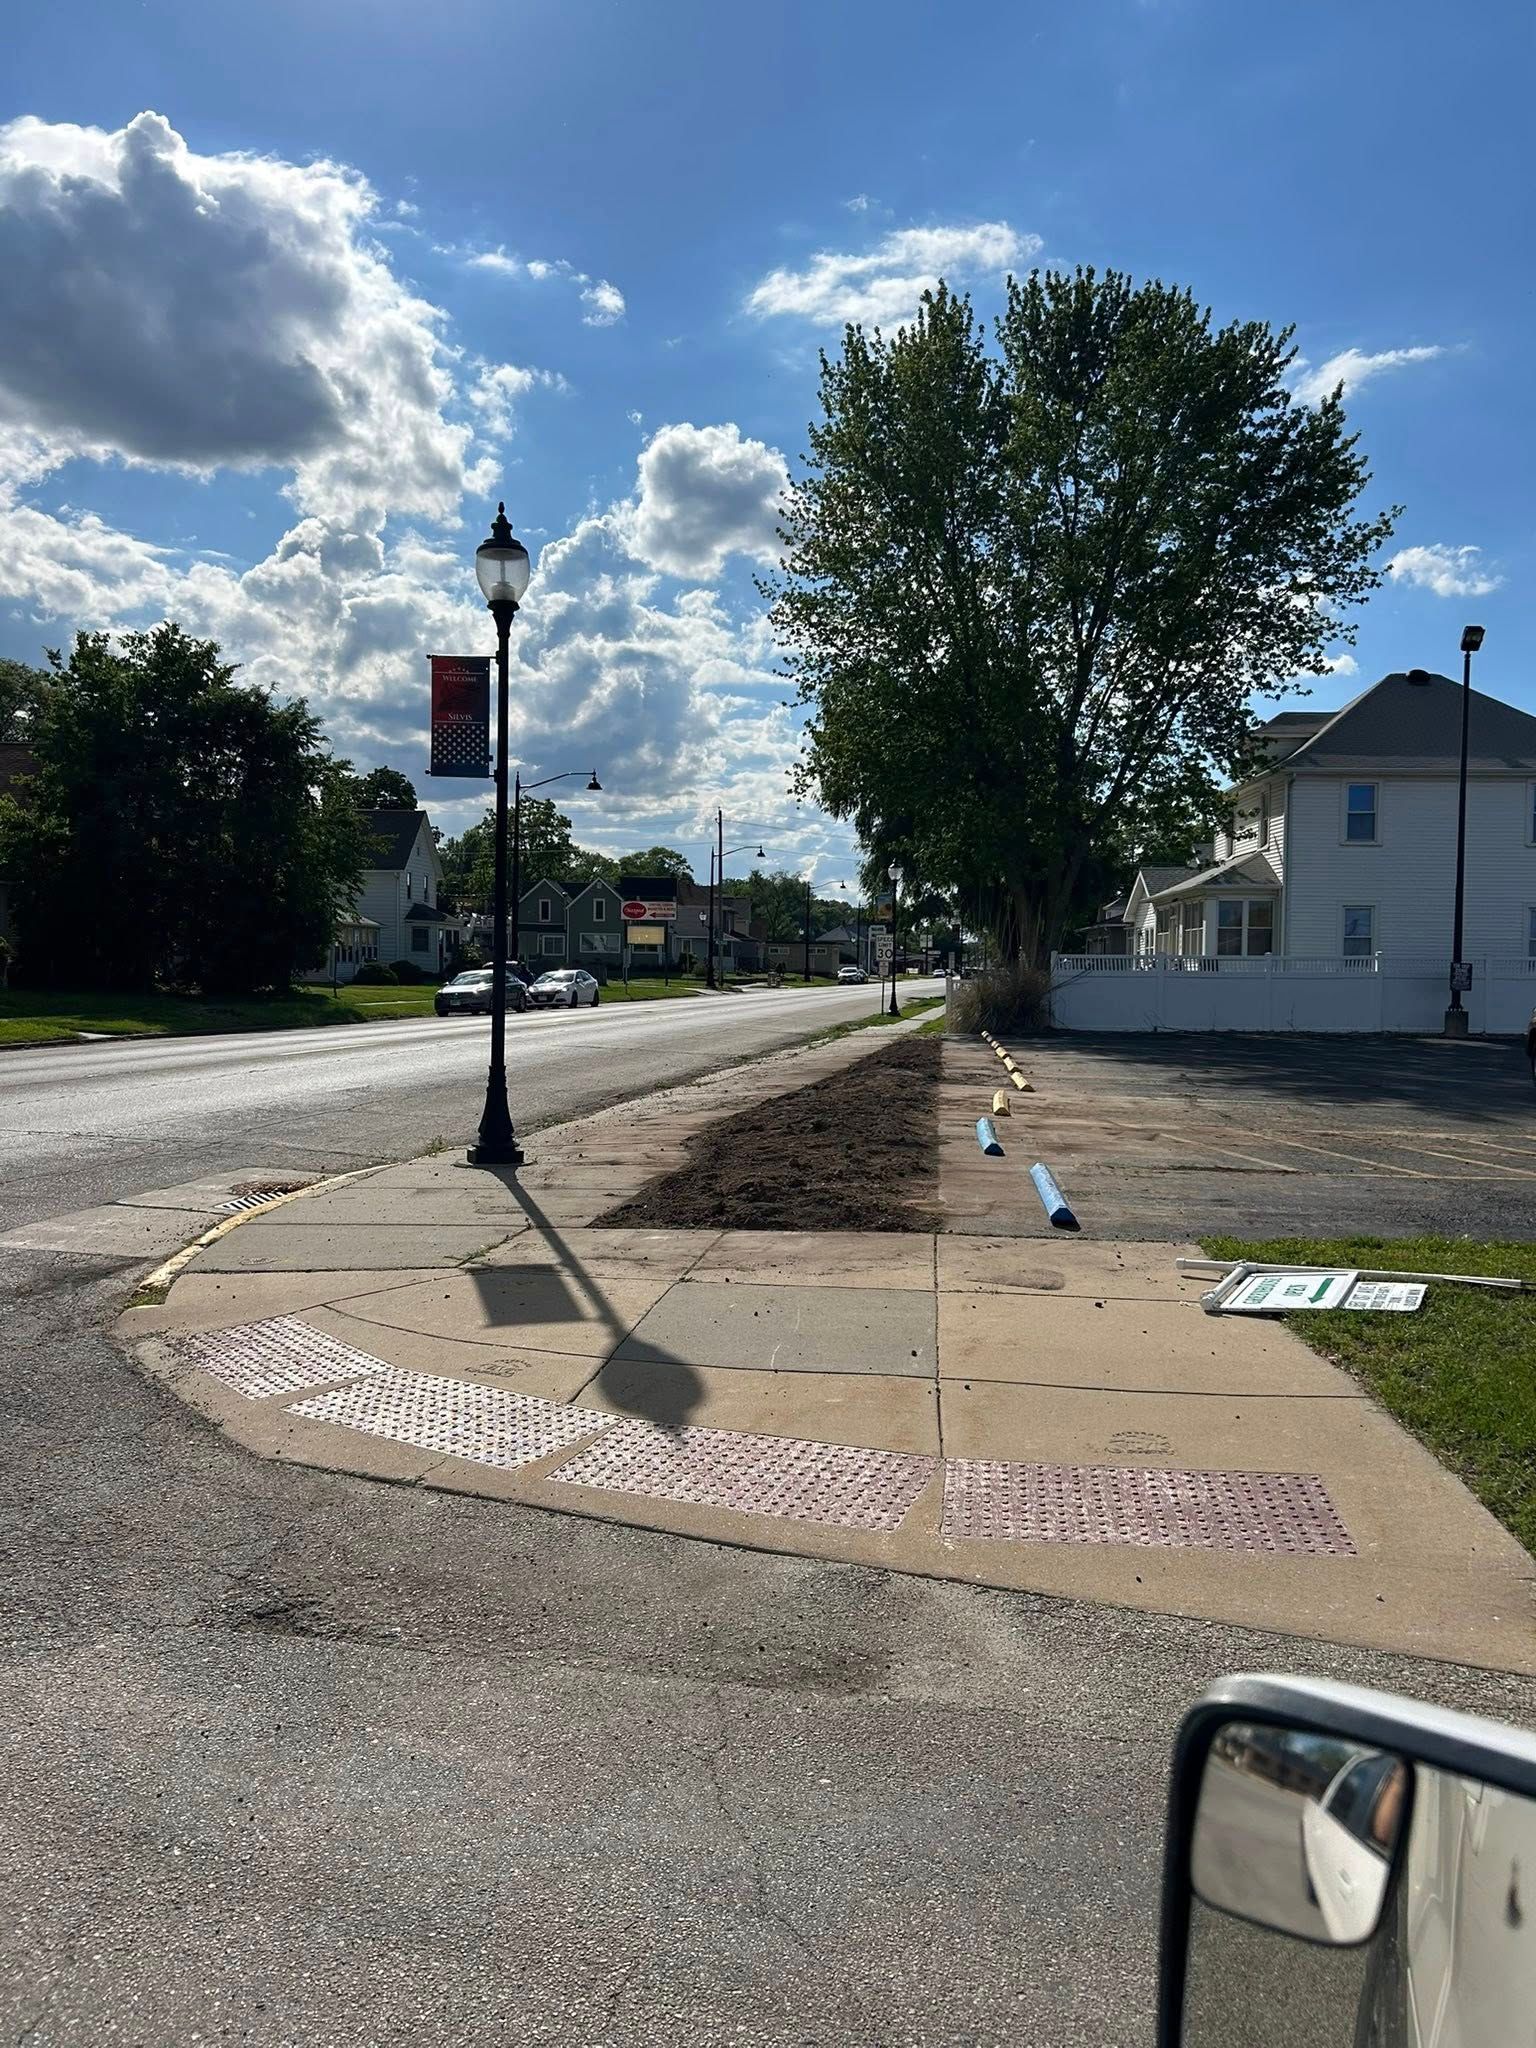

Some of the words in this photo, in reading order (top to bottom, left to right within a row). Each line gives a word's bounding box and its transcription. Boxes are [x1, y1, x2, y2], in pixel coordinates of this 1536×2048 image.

[448, 712, 473, 720] SILVIS
[878, 948, 894, 959] 30
[1242, 1277, 1283, 1304] GREENHOUSE
[1283, 1285, 1308, 1296] OPEN
